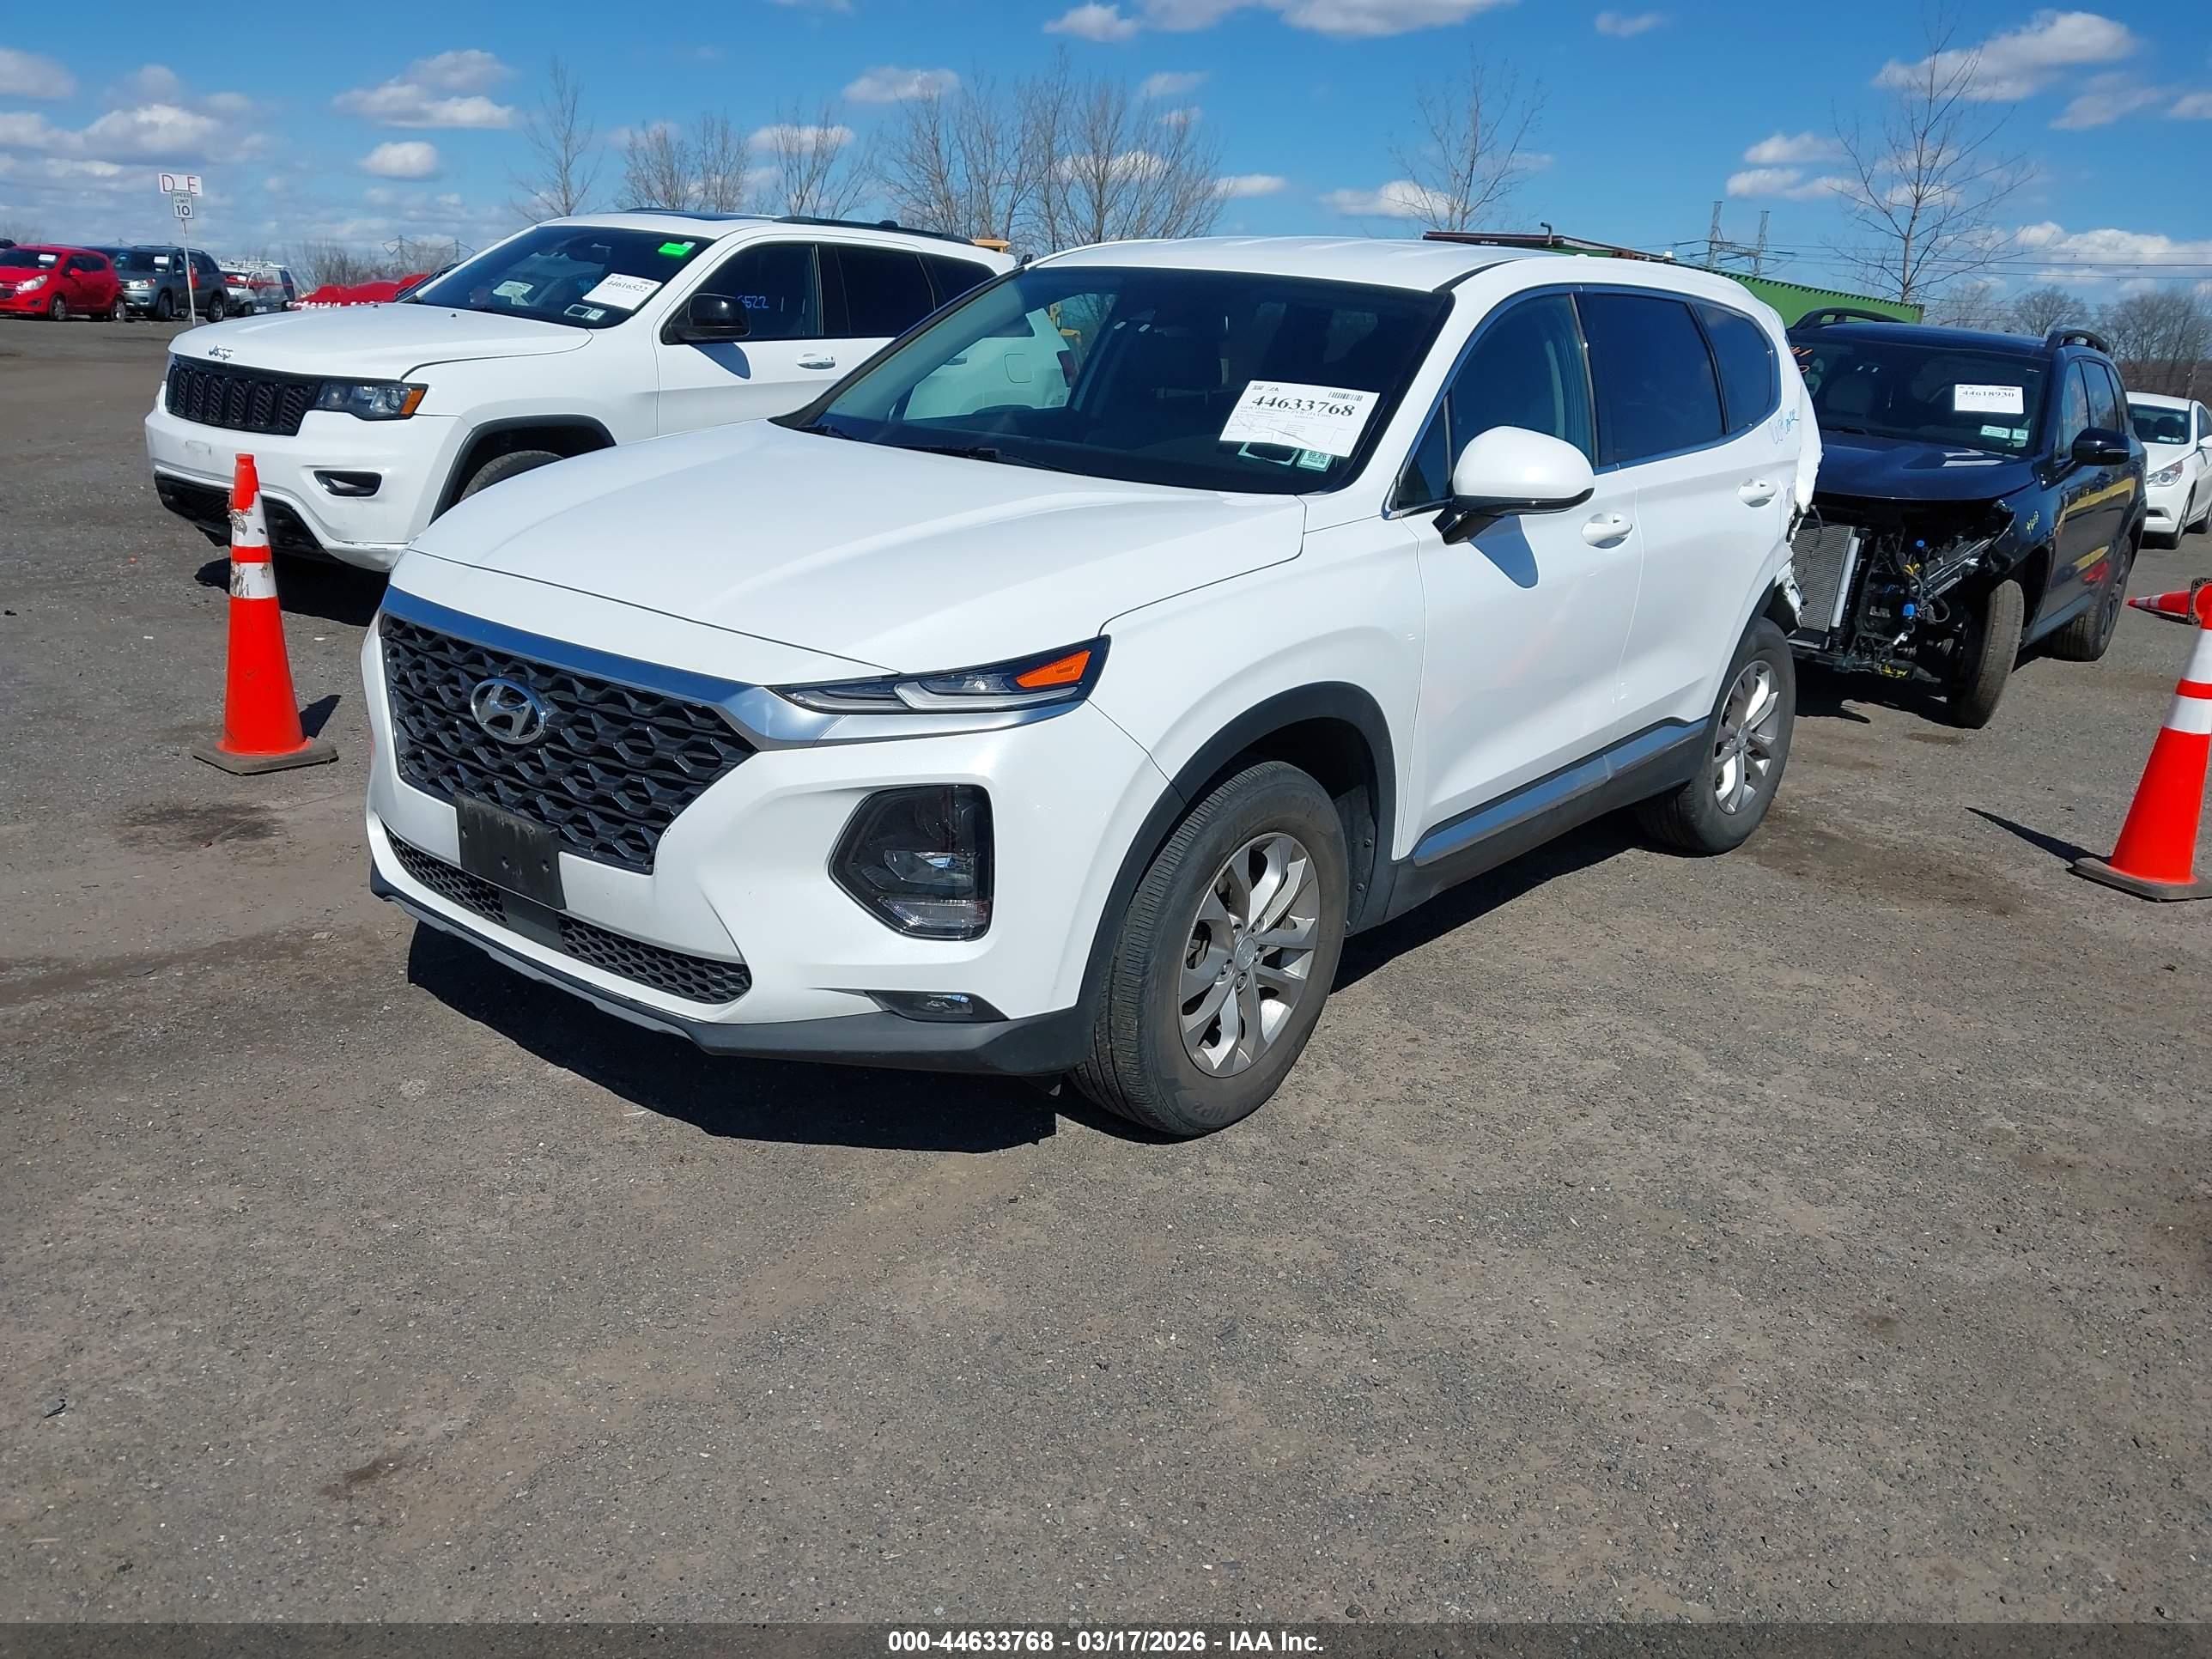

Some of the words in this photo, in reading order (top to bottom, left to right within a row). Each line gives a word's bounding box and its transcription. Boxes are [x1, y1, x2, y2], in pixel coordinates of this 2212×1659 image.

[161, 174, 175, 192] D
[187, 176, 198, 195] E
[176, 205, 190, 216] 10
[1252, 395, 1355, 417] 44633768
